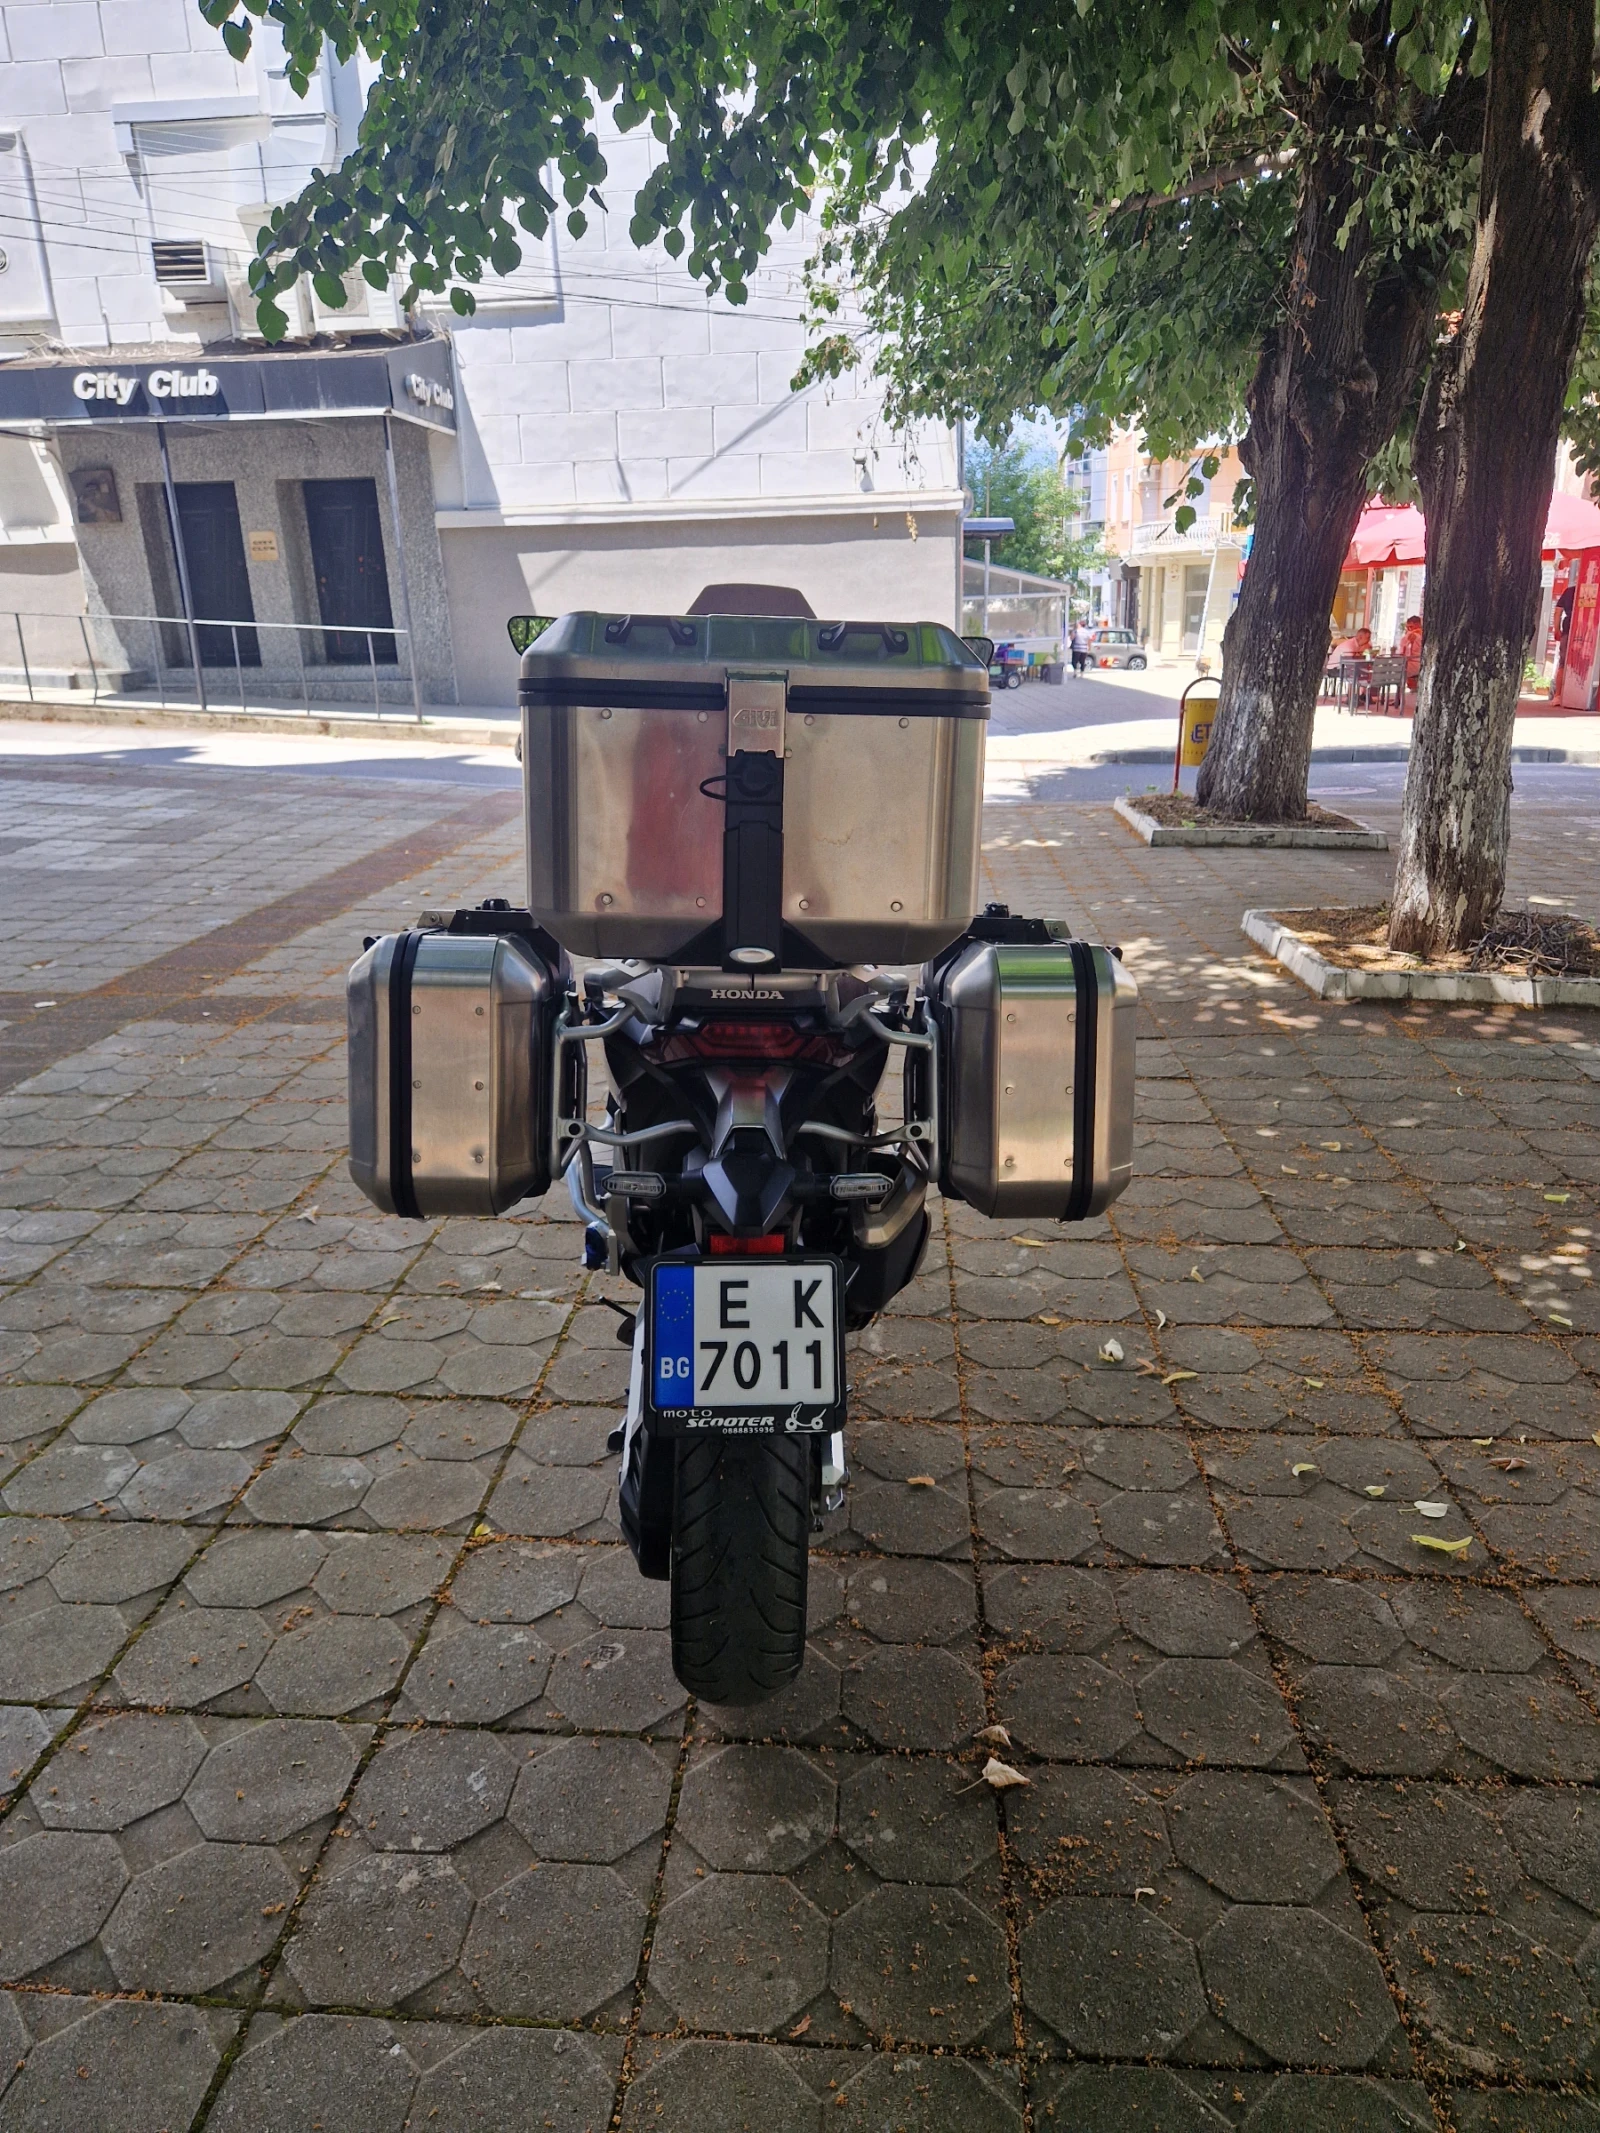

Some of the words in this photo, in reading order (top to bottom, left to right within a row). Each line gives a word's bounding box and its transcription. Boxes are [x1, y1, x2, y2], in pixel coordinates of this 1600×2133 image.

[73, 372, 140, 405] City
[148, 369, 219, 397] Club
[408, 374, 431, 407] City
[432, 383, 454, 410] Club
[733, 708, 777, 729] GIVI
[710, 989, 785, 1000] HONDA
[720, 1280, 750, 1329] E
[794, 1280, 825, 1328] K
[660, 1356, 690, 1379] BG
[700, 1340, 822, 1391] 7011
[663, 1409, 713, 1418] moto
[685, 1416, 775, 1428] SCOOTER
